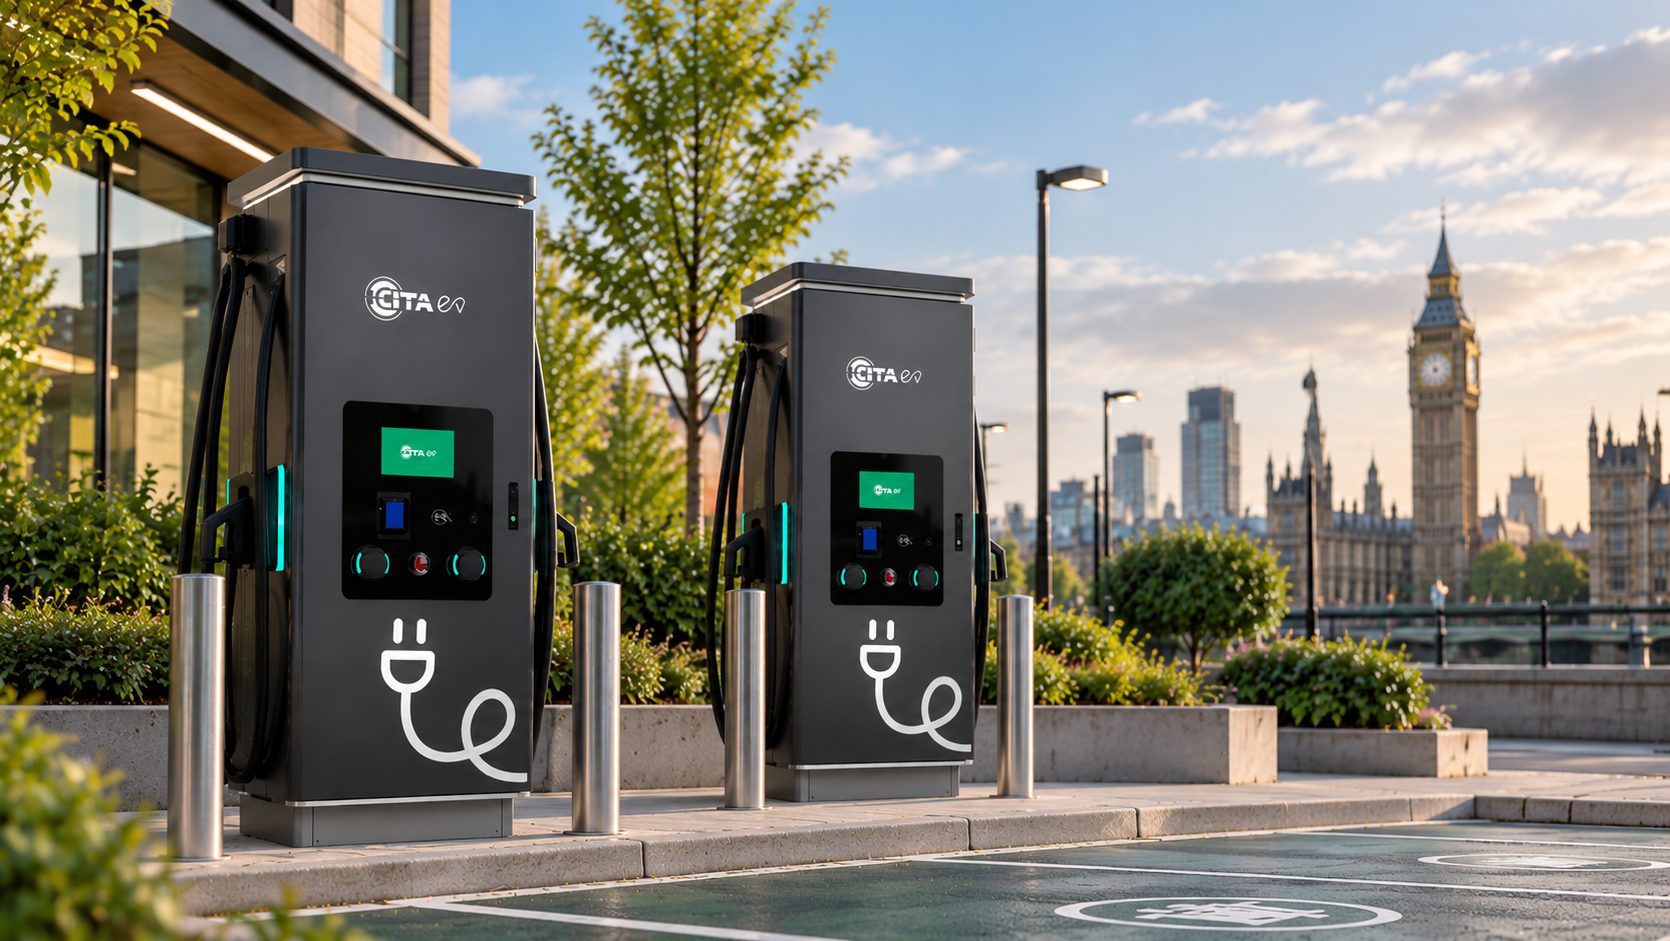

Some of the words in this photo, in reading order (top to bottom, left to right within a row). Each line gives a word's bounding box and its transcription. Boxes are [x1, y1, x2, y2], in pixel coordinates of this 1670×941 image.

[369, 280, 434, 317] CITA
[437, 295, 466, 314] ev
[900, 369, 922, 384] ev
